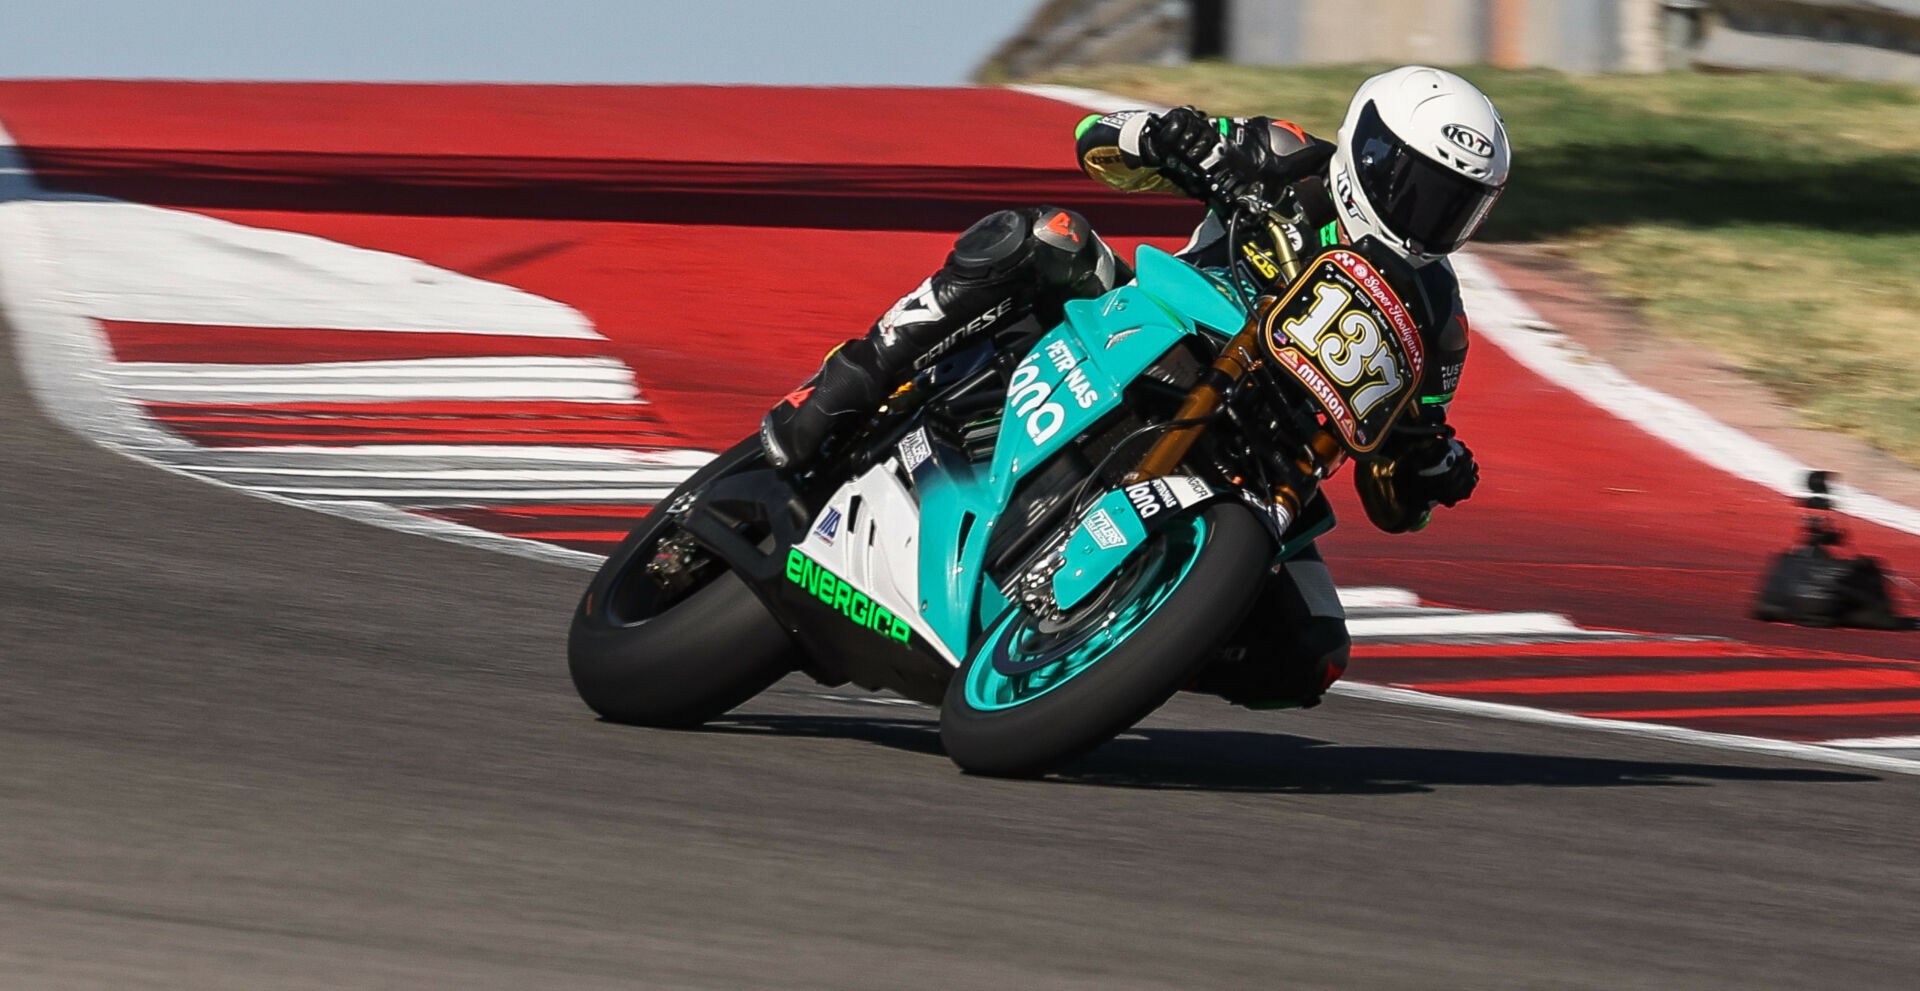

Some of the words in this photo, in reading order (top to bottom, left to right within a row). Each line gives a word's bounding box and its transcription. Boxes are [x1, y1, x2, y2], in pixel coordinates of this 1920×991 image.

[1447, 124, 1491, 156] KYT
[1363, 275, 1392, 307] Super
[1388, 304, 1417, 354] Hooligan
[1044, 339, 1098, 409] PETRNAS
[1282, 282, 1403, 420] 137
[1298, 363, 1345, 420] MISSION
